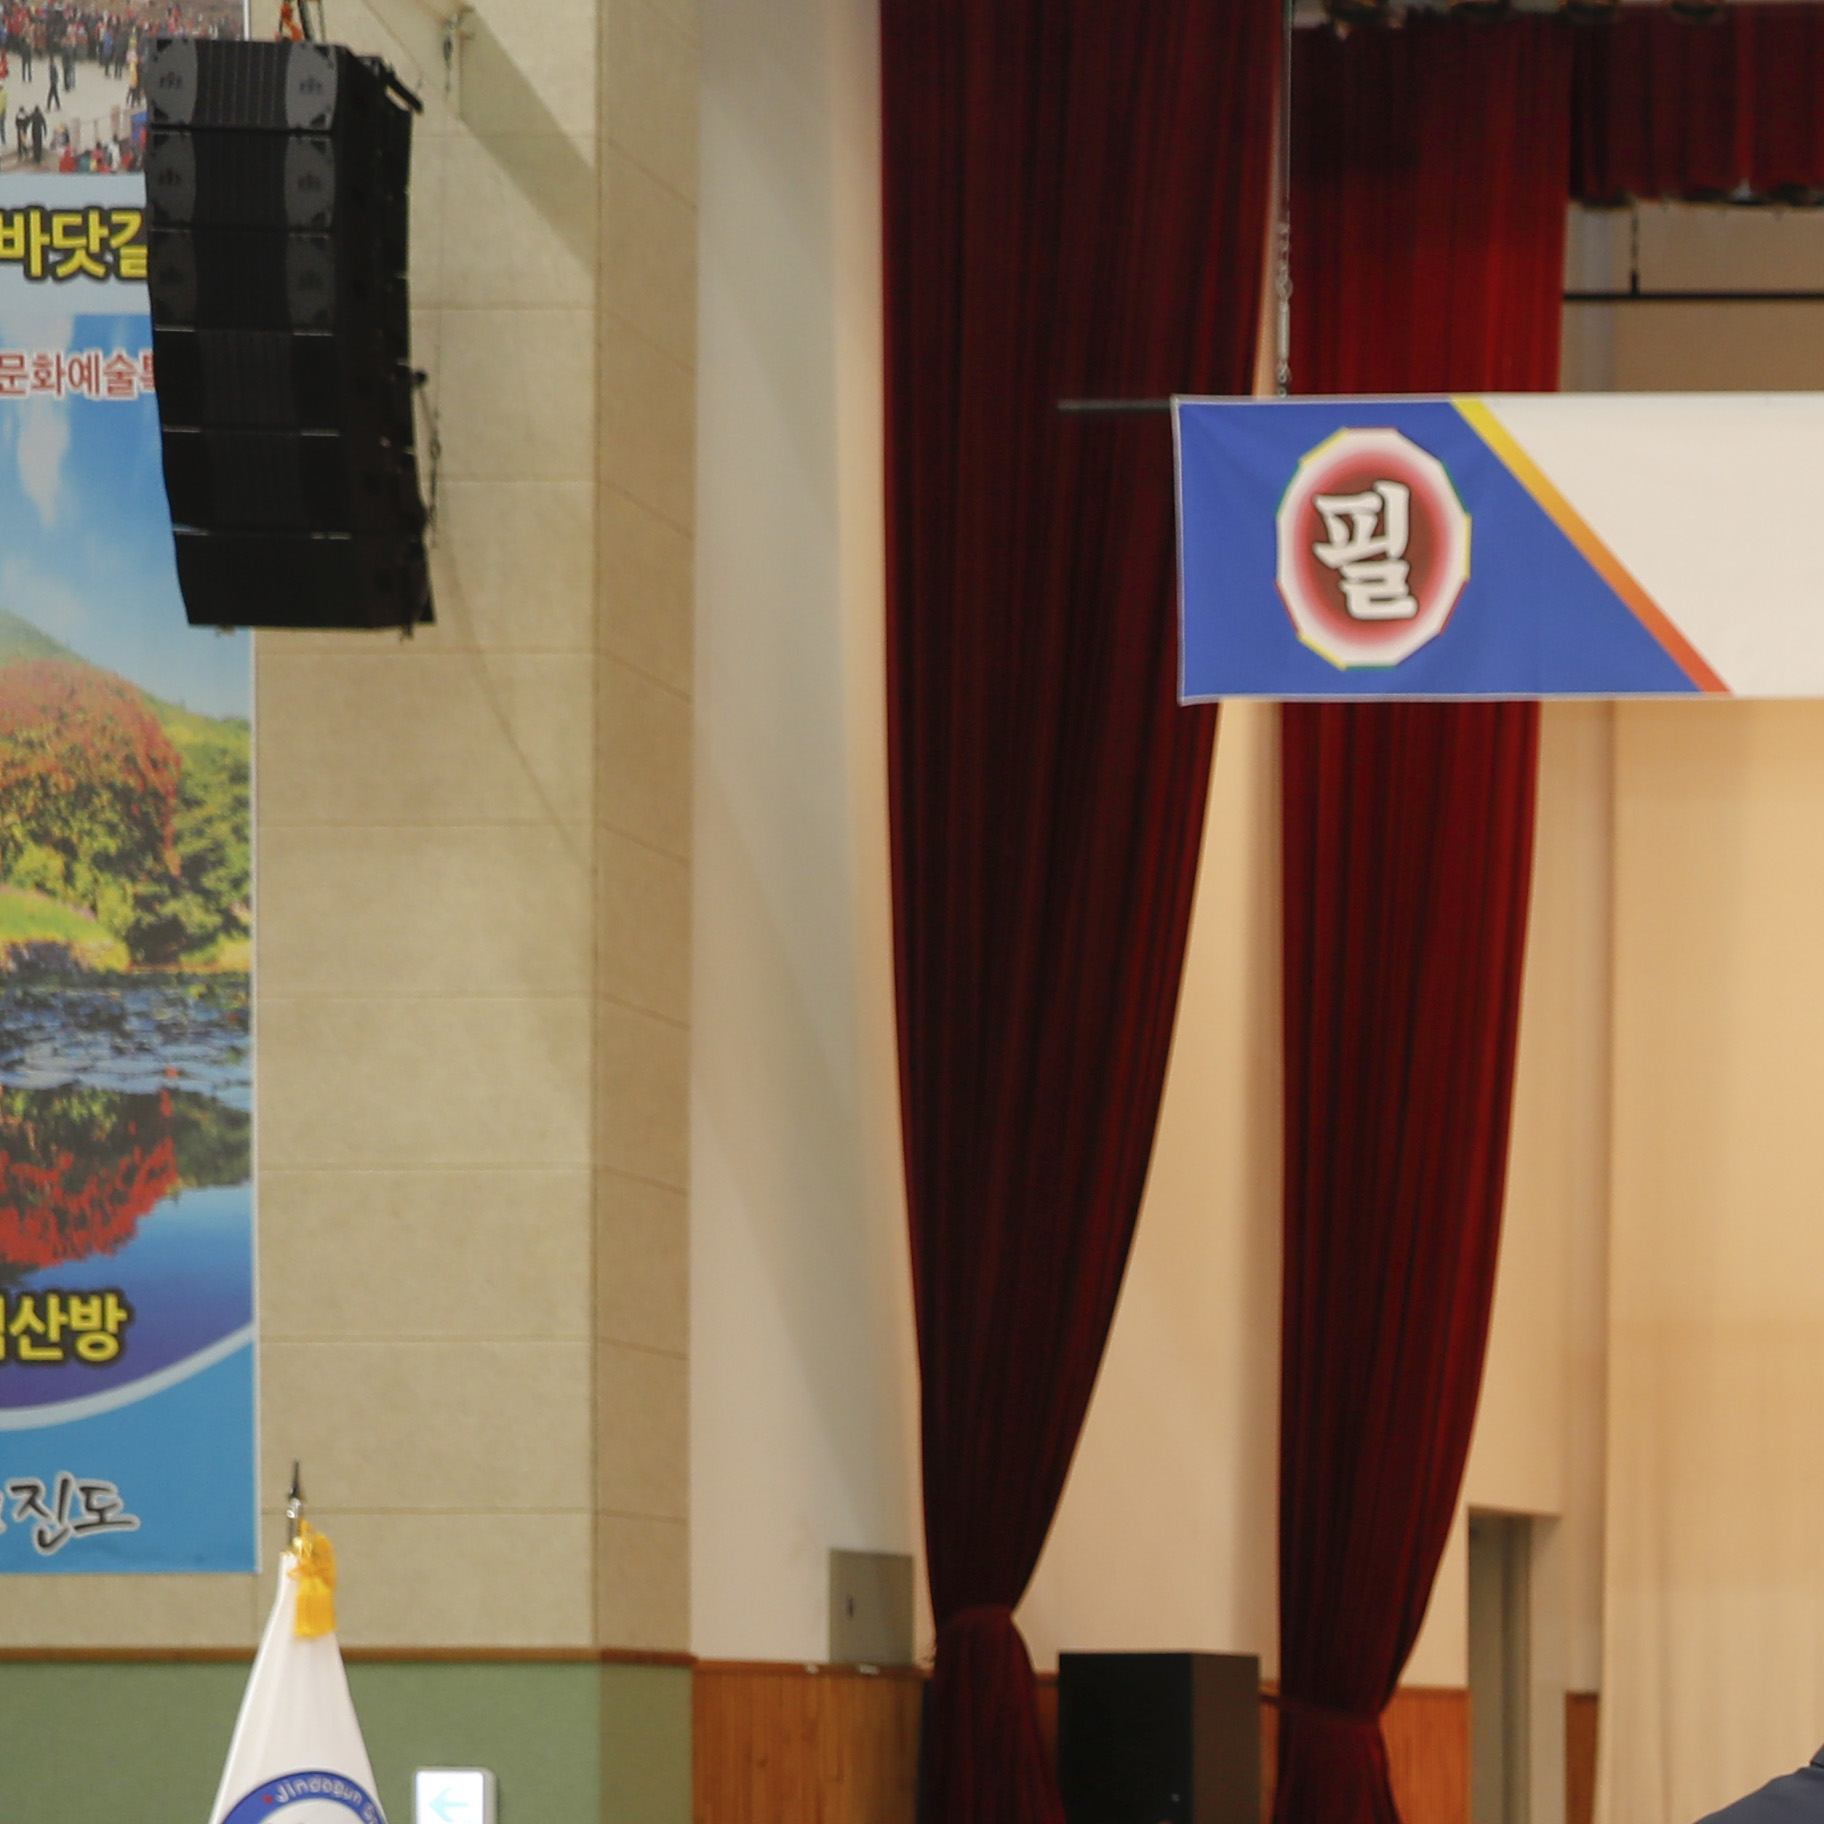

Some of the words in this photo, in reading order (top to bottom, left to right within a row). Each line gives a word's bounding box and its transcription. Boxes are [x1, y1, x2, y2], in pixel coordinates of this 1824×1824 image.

[1312, 480, 1419, 621] 필
[0, 1292, 128, 1362] 산방
[9, 1476, 136, 1550] 진도
[275, 1776, 364, 1805] Jindogun
